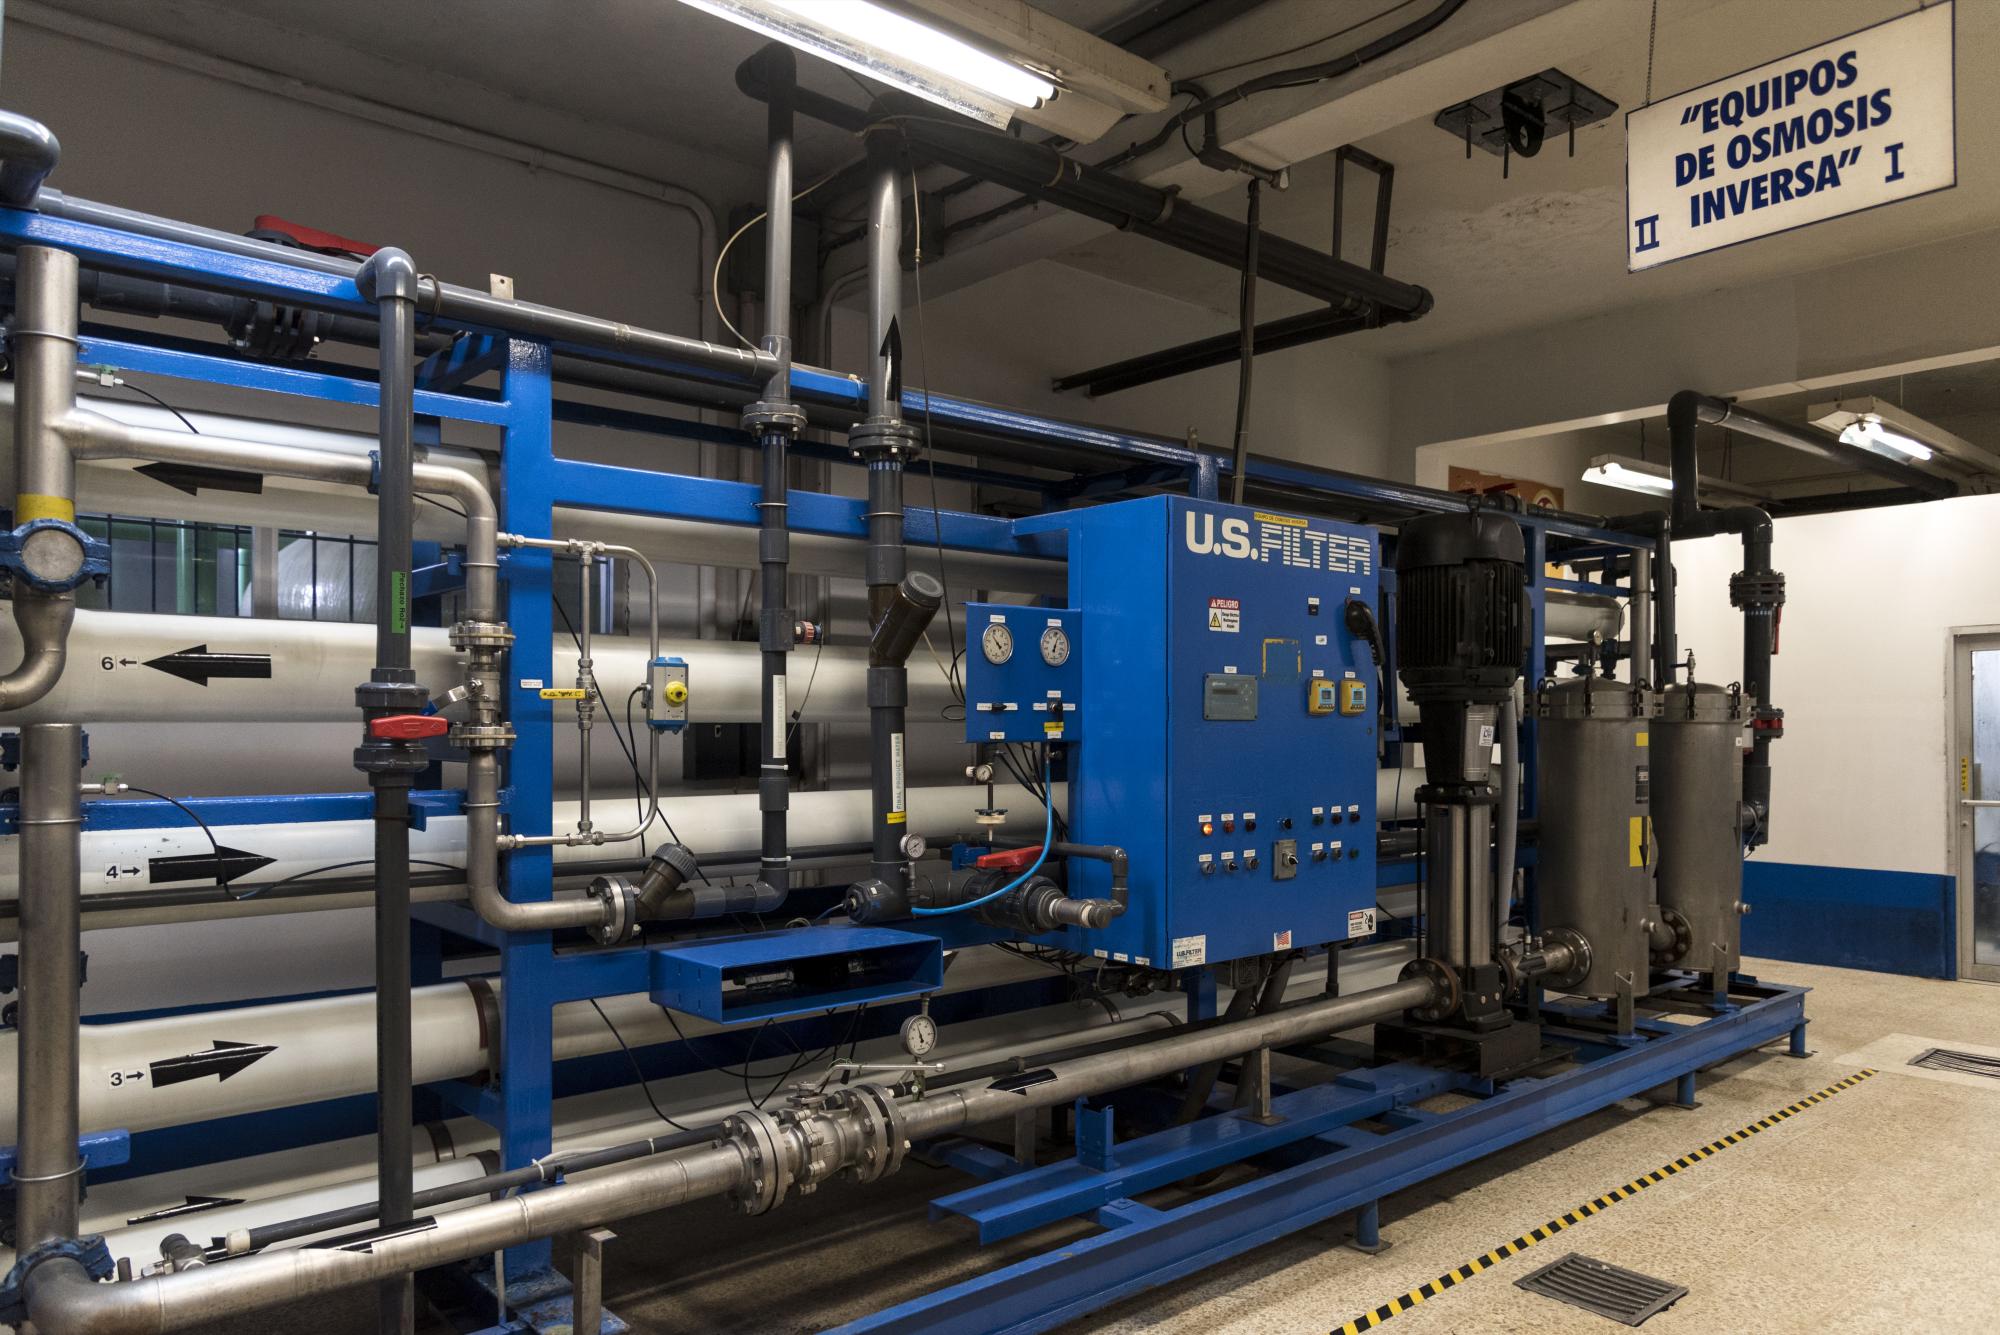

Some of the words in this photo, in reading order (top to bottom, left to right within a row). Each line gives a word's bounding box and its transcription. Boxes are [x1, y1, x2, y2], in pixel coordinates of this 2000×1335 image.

[1675, 143, 1715, 188] DE
[1726, 88, 1892, 170] OSMOSIS
[1884, 142, 1905, 184] I
[1634, 214, 1660, 254] II
[1216, 599, 1239, 609] PELIGRO
[101, 656, 114, 671] 6
[106, 865, 119, 879] 4
[110, 1072, 123, 1087] 3
